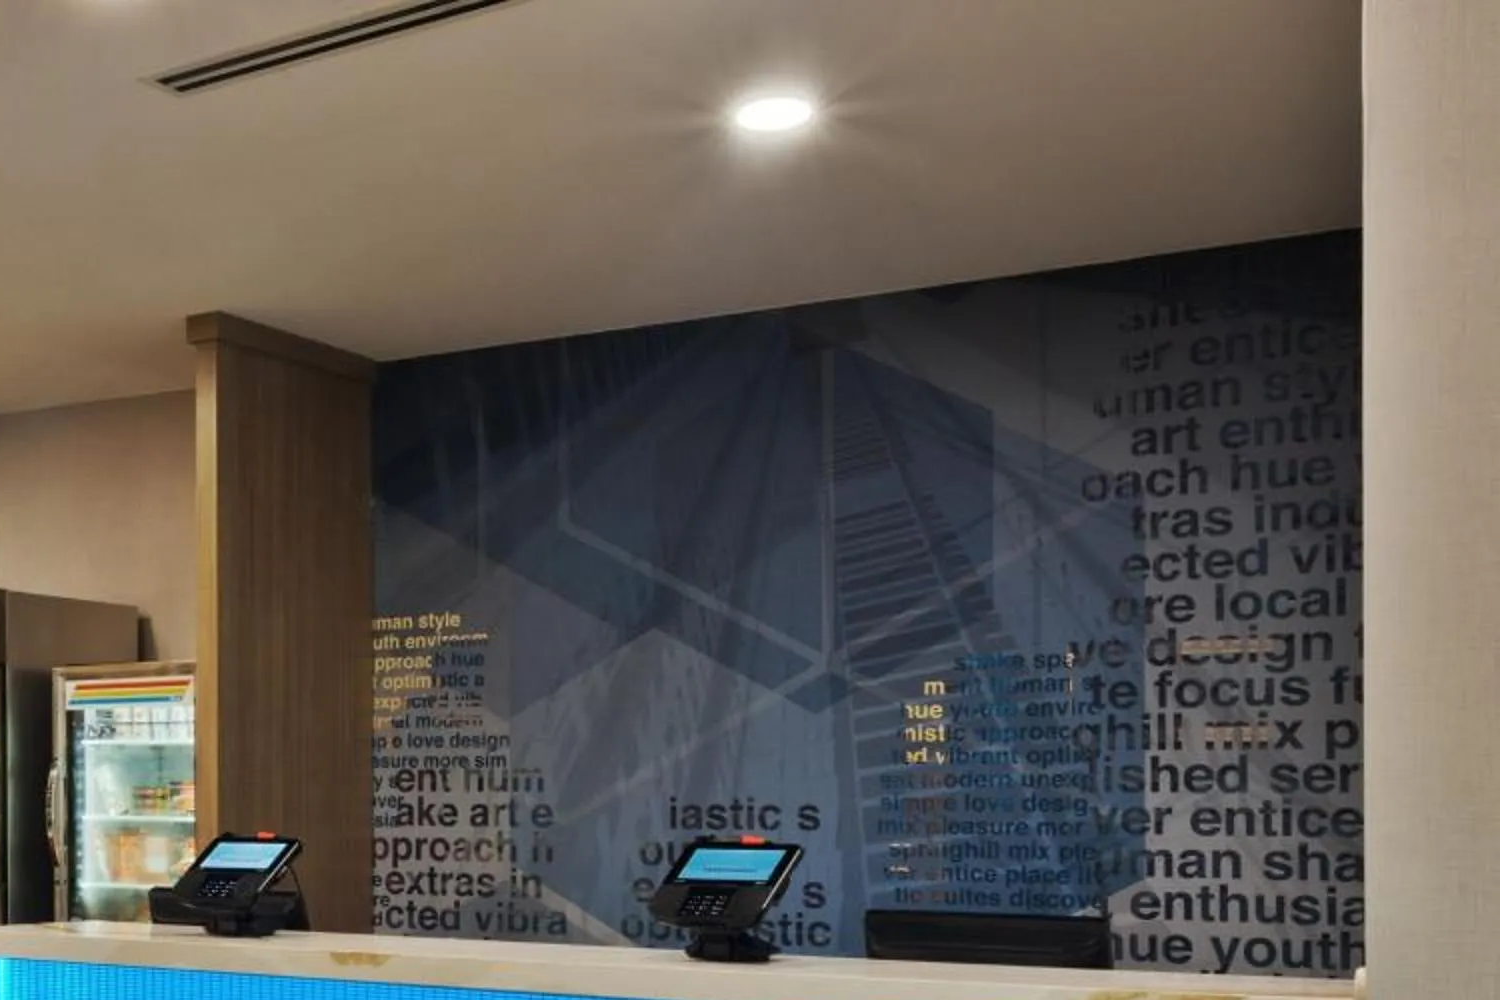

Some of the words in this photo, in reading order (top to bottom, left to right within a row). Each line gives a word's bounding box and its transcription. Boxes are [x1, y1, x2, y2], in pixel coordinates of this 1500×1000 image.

[1131, 416, 1202, 457] art
[1081, 458, 1208, 502] oach
[1230, 453, 1335, 493] hue
[1132, 503, 1234, 541] tras
[1121, 538, 1269, 583] ected
[1215, 582, 1347, 622] local
[418, 611, 461, 634] style
[1153, 670, 1311, 709] focus
[408, 732, 445, 749] love
[449, 732, 511, 753] design
[1270, 762, 1360, 794] ser
[470, 798, 519, 827] art
[532, 803, 554, 828] e
[669, 797, 781, 831] iastic
[797, 804, 821, 831] s
[1190, 795, 1364, 838] entice
[385, 866, 496, 898] extras
[803, 881, 827, 909] s
[385, 900, 461, 931] cted
[475, 901, 568, 935] vibra
[1130, 886, 1364, 926] enthusia
[1210, 931, 1365, 974] youth
